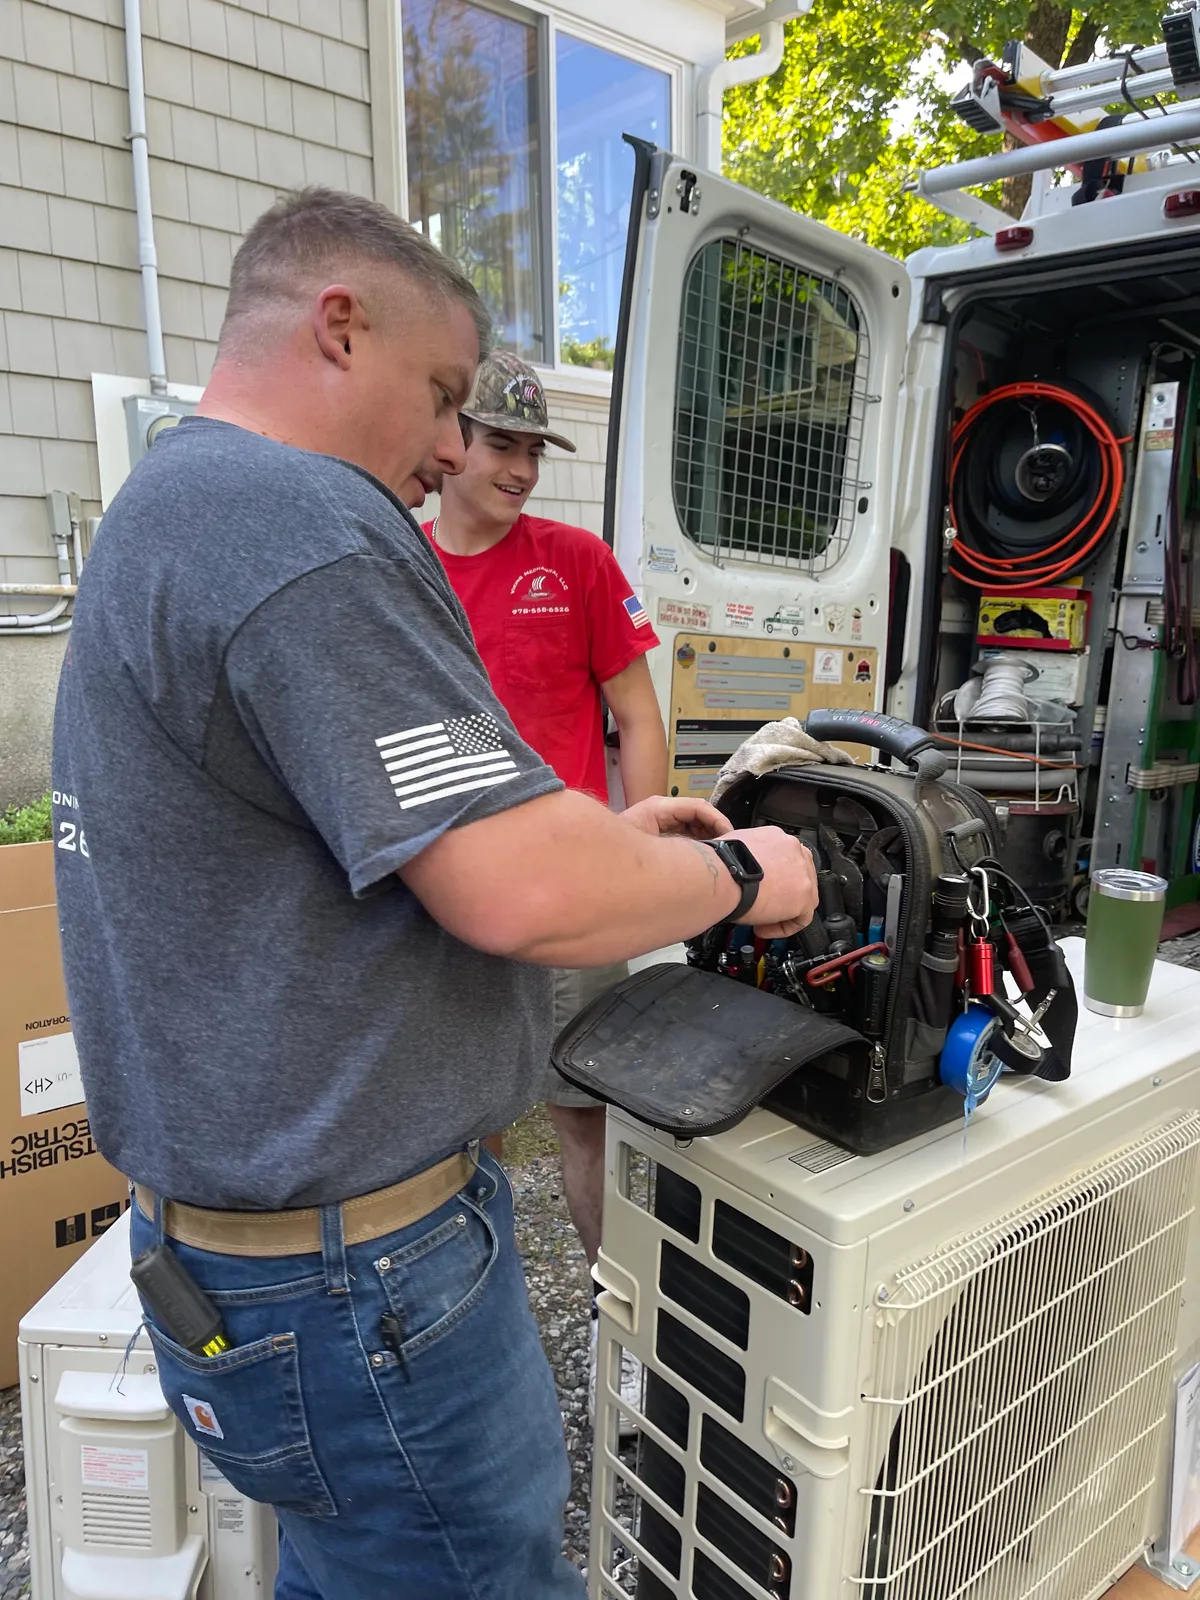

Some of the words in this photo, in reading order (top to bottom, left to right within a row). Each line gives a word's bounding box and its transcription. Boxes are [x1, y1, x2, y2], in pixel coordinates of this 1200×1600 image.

[523, 566, 558, 578] MECHANICAL
[559, 577, 569, 591] LLC
[832, 714, 858, 722] VETO
[860, 717, 880, 727] PRO
[881, 723, 899, 734] PAC
